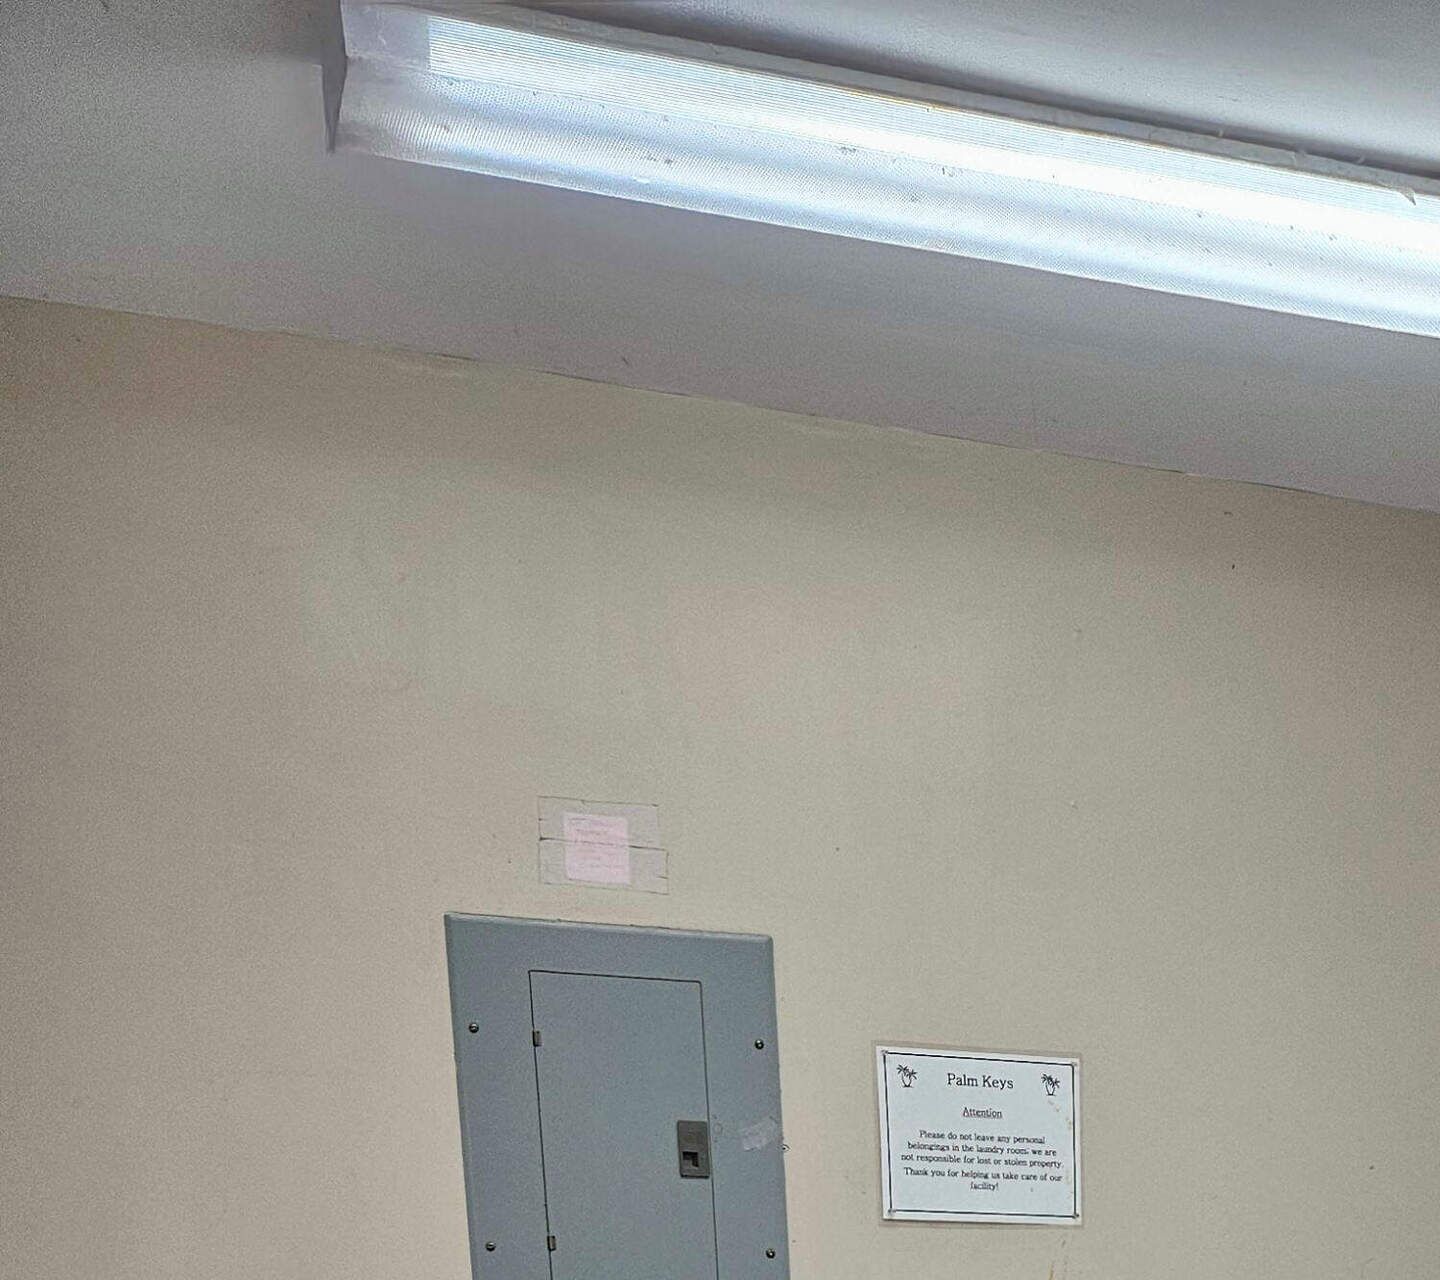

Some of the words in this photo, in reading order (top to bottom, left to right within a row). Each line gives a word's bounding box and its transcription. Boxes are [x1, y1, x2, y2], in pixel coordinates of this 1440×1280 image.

[947, 1072, 979, 1087] Palm
[982, 1075, 1014, 1090] Keys
[963, 1106, 1003, 1119] Attention
[919, 1130, 945, 1139] Please
[948, 1131, 957, 1140] do
[960, 1133, 972, 1141] not
[975, 1133, 994, 1142] leave
[998, 1135, 1010, 1143] any
[1014, 1136, 1045, 1144] personal
[908, 1141, 949, 1151] belongings
[952, 1143, 960, 1151] in
[962, 1144, 974, 1152] the
[977, 1144, 1004, 1154] laundry
[916, 1154, 961, 1163] responsible
[964, 1155, 974, 1163] for
[977, 1156, 991, 1165] lost
[1004, 1158, 1028, 1166] stolen
[904, 1166, 928, 1176] Thank
[931, 1169, 945, 1177] you
[947, 1169, 959, 1177] for
[961, 1170, 989, 1179] helping
[1002, 1172, 1019, 1180] take
[1040, 1173, 1047, 1181] of
